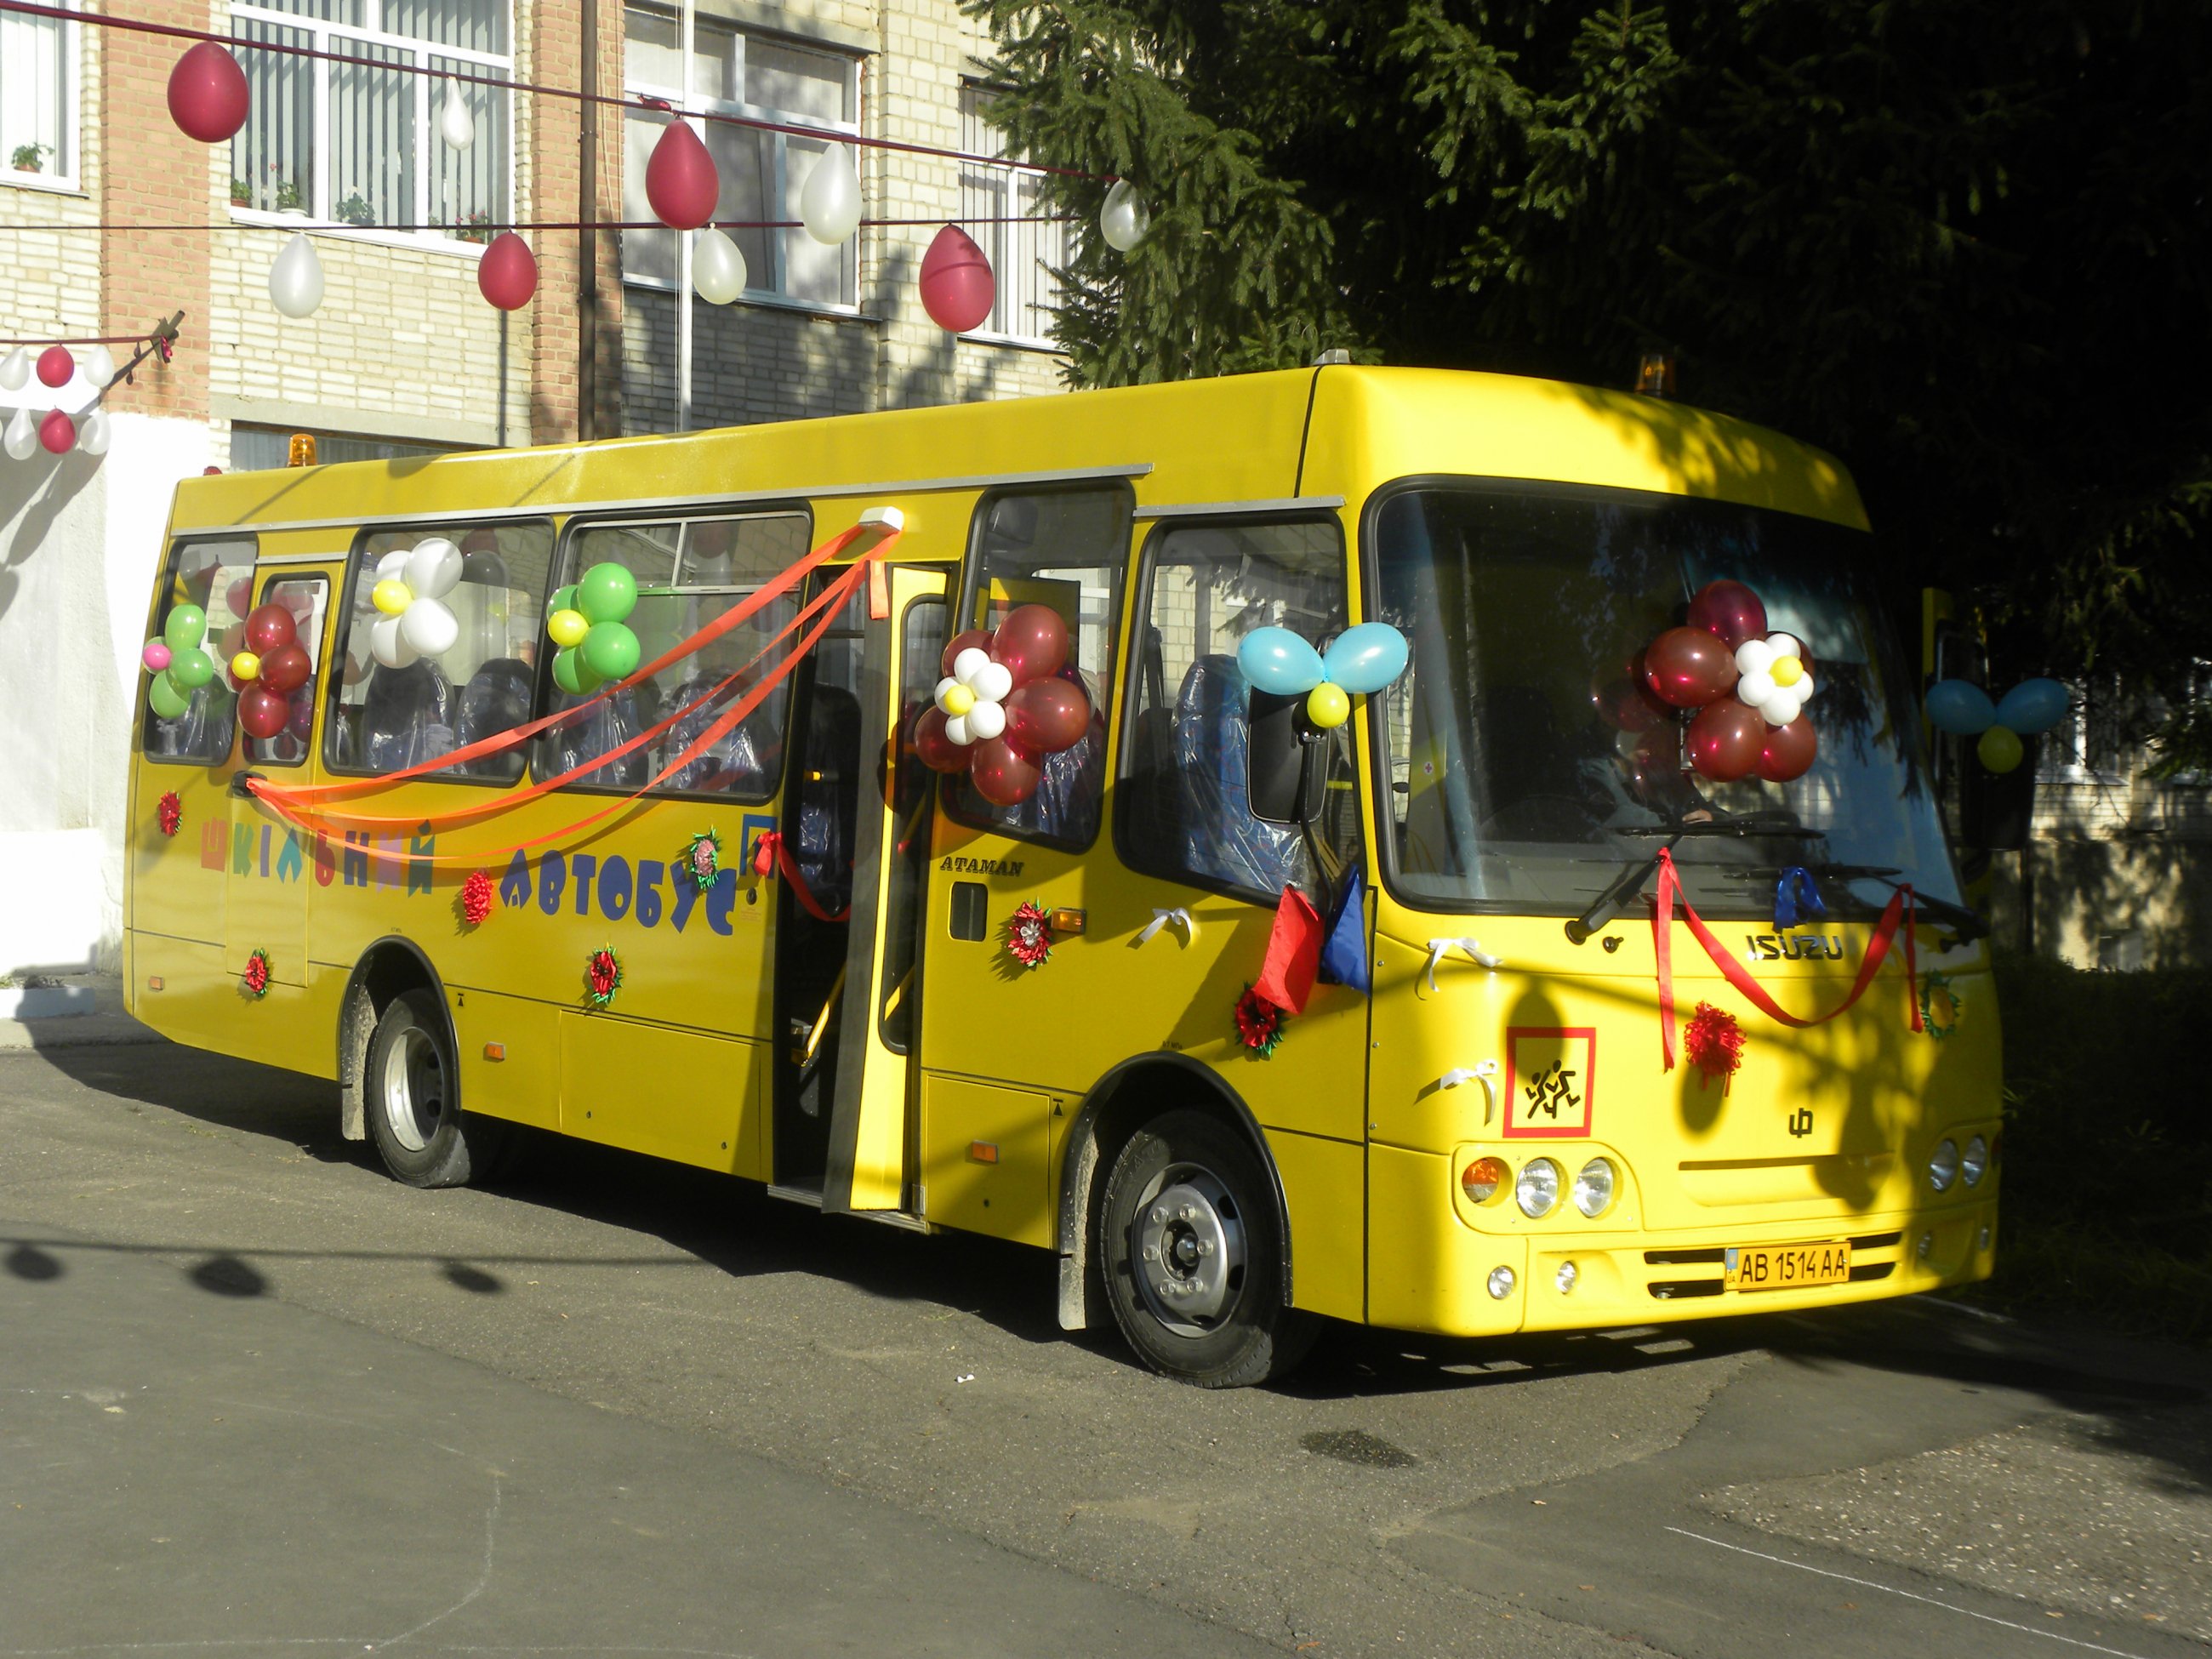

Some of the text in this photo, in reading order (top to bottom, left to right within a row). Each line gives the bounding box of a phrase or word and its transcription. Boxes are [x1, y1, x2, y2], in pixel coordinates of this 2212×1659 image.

[940, 856, 1024, 877] ATAMAN
[499, 848, 737, 936] АВТОБУС
[1746, 935, 1844, 961] ISUZU
[1727, 1274, 1736, 1284] UA
[1740, 1249, 1845, 1283] AB 1514 AA
